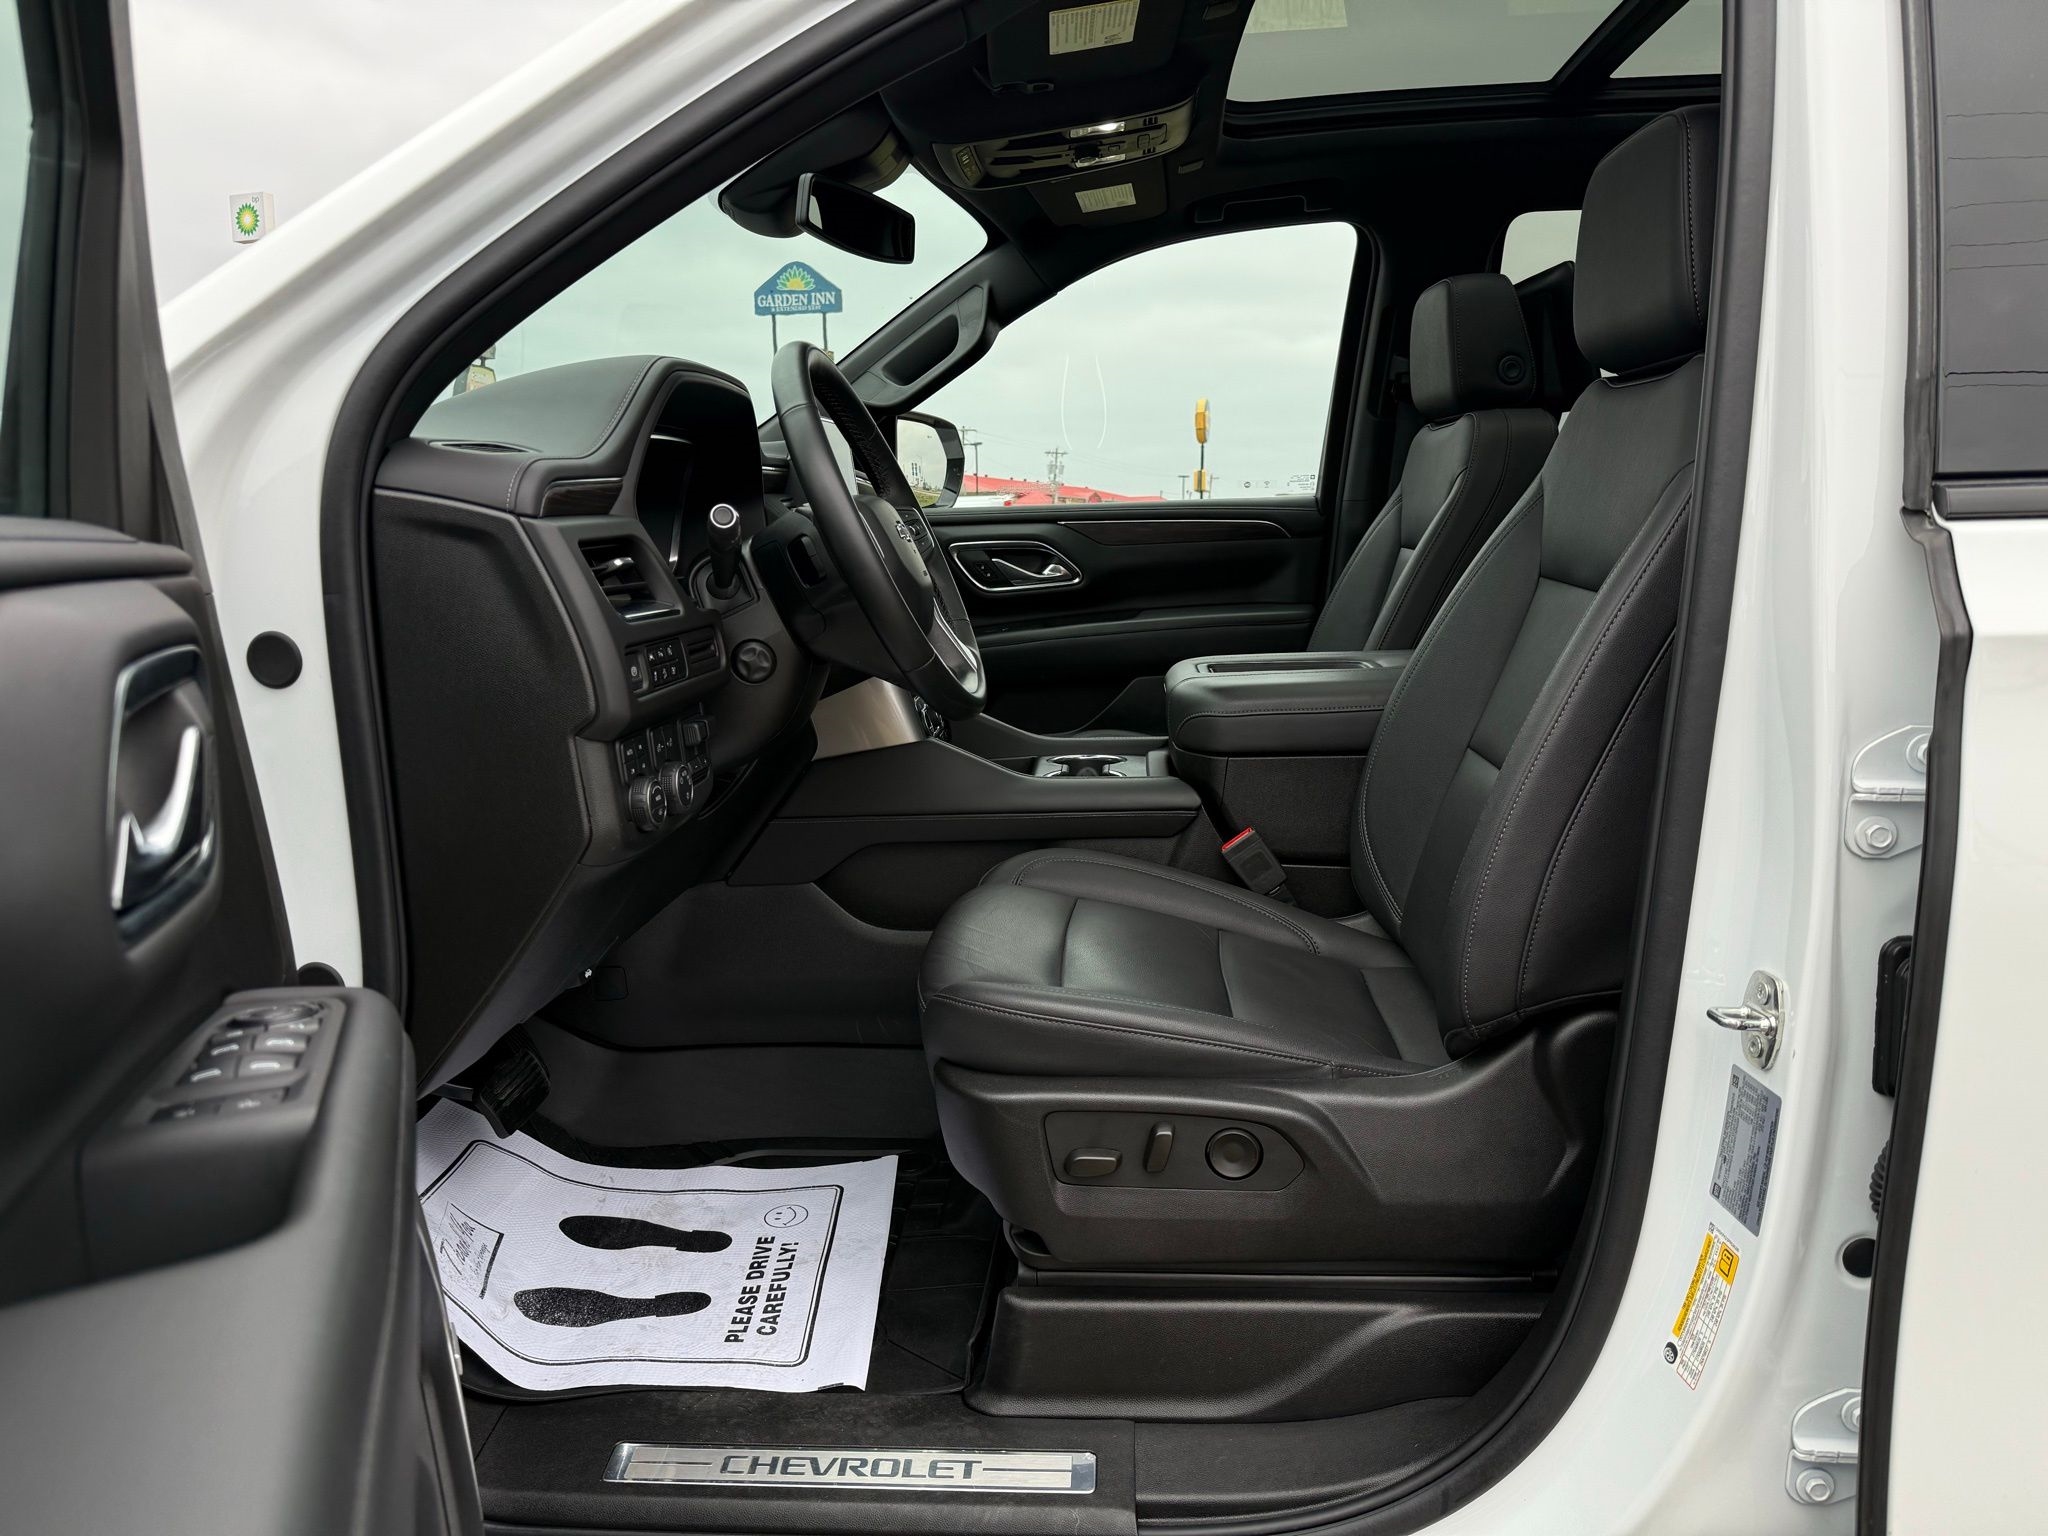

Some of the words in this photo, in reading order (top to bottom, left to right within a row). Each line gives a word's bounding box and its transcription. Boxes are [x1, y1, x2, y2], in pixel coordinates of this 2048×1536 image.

[757, 294, 808, 307] GARDEN
[811, 292, 836, 305] INN
[724, 1285, 761, 1342] PLEASE
[746, 1236, 776, 1280] DRIVE
[756, 1242, 799, 1335] CAREFULLY!
[719, 1455, 983, 1479] CHEVROLET
